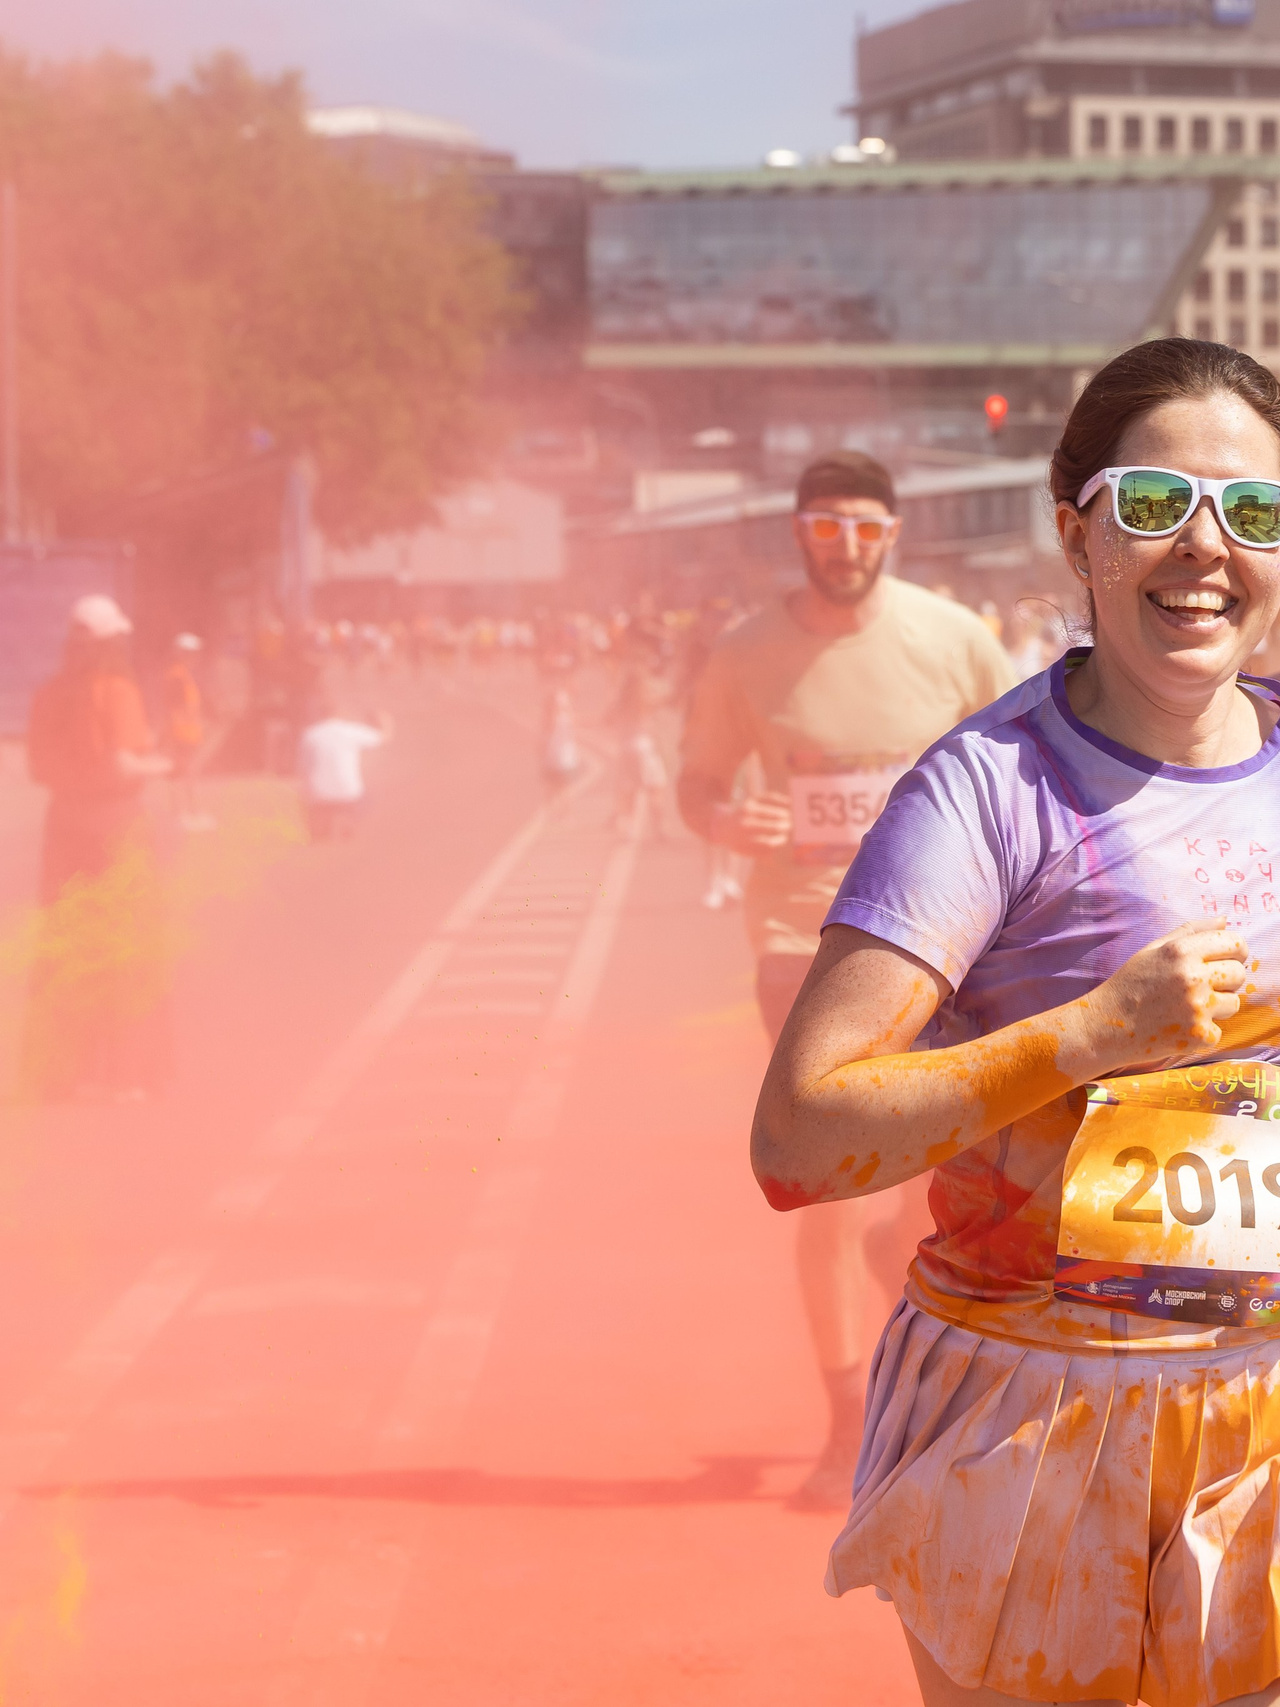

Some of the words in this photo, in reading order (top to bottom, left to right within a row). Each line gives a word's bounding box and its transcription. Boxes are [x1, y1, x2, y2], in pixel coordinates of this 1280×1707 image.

[1184, 837, 1268, 858] КРА
[1165, 1289, 1206, 1301] МОСКОВСКИЙ
[1164, 1297, 1185, 1307] СПОРТ
